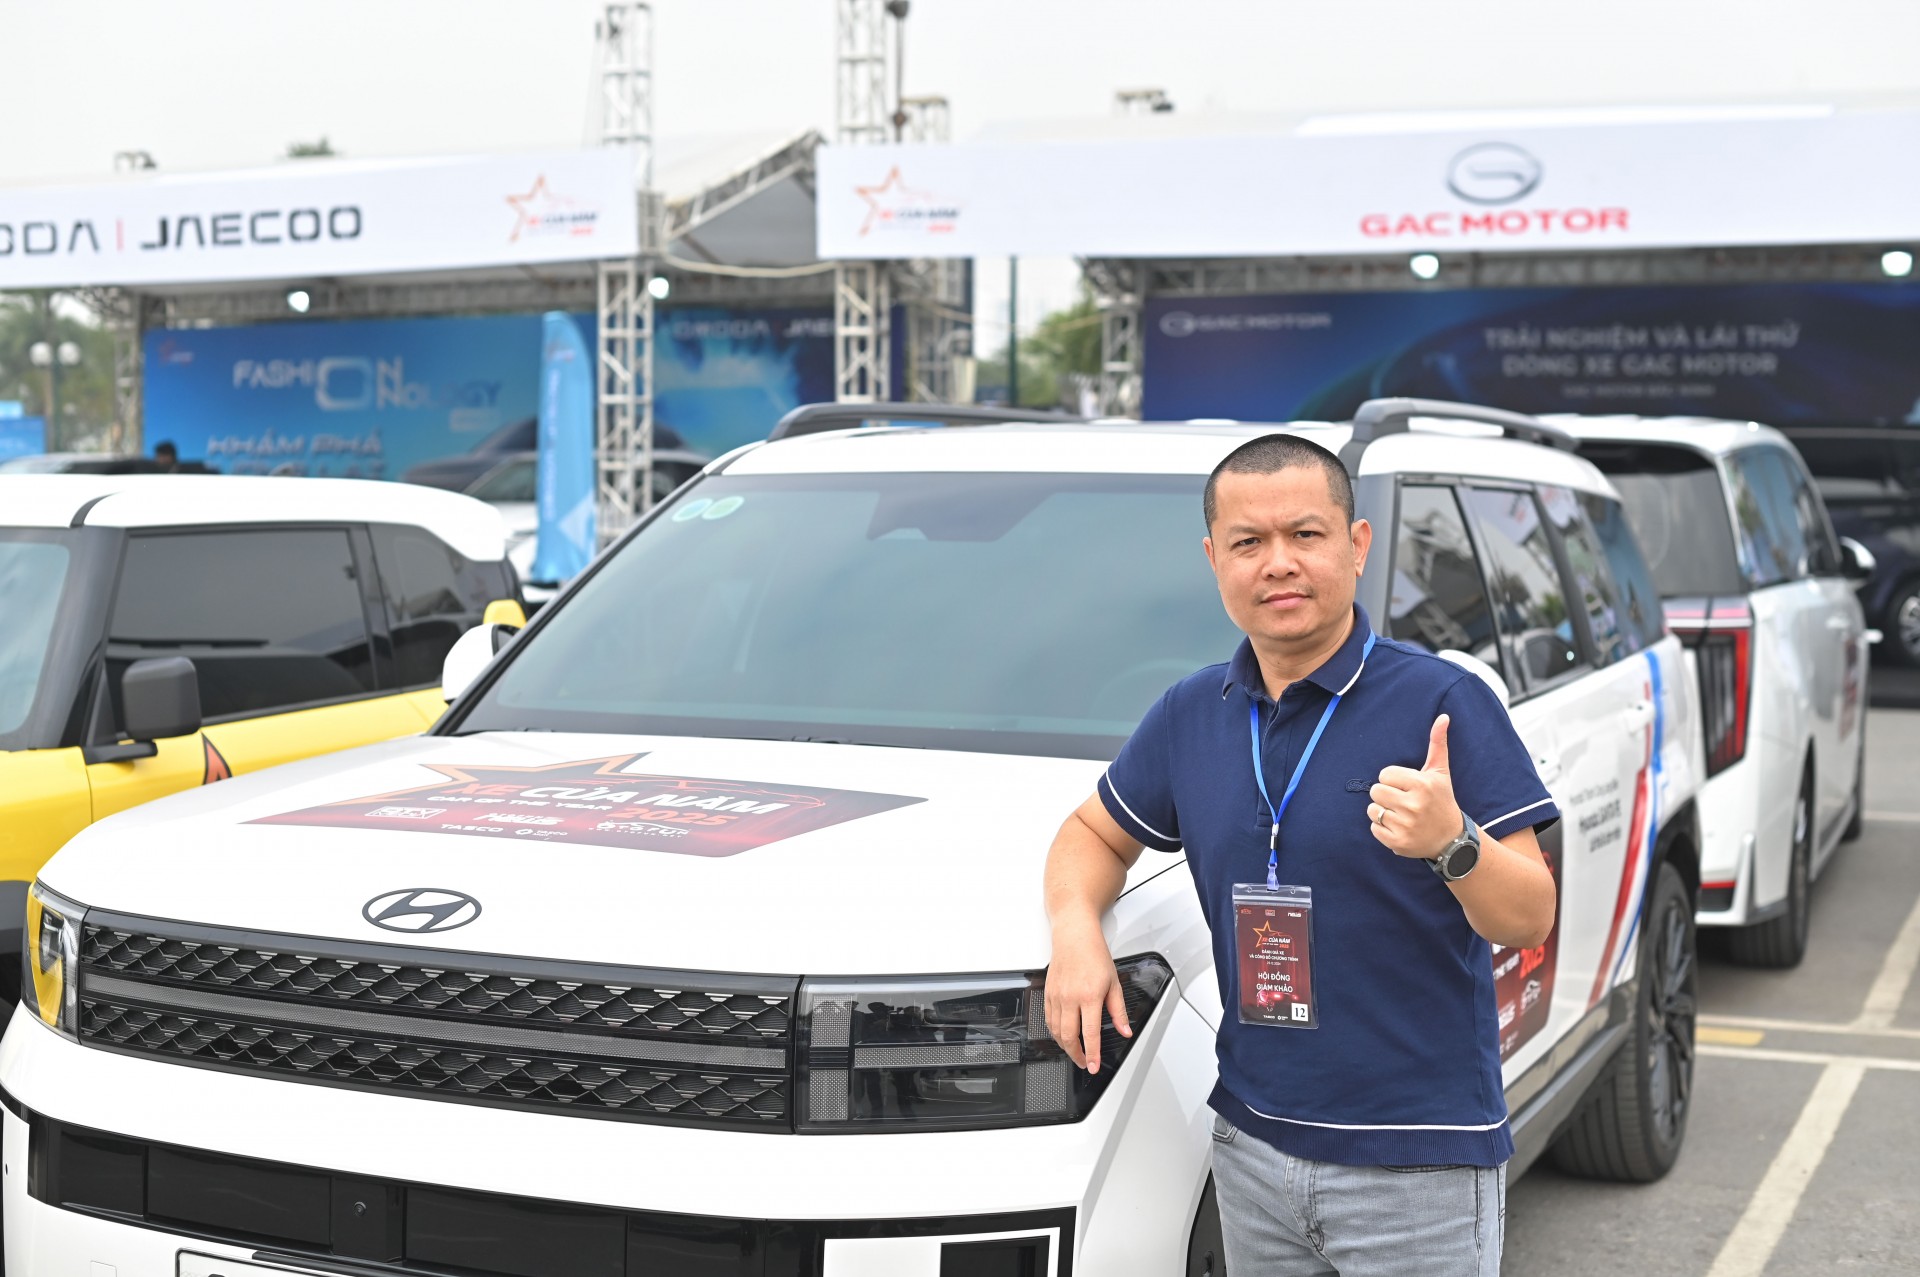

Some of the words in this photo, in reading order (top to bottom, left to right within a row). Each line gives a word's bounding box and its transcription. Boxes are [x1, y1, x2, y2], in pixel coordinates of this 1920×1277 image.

[141, 207, 362, 250] JAECOO
[1360, 212, 1449, 237] GAC
[1460, 208, 1630, 235] MOTOR
[1197, 315, 1242, 331] GAC
[1246, 313, 1331, 330] MOTOR
[1621, 352, 1676, 376] GAC
[1682, 352, 1778, 375] MOTOR
[440, 783, 531, 795] XE
[519, 786, 640, 803] CỦA
[639, 793, 790, 815] NĂM
[509, 799, 550, 807] THE
[555, 802, 612, 811] YEAR
[606, 807, 739, 826] 2025
[441, 824, 503, 833] TASCO
[1256, 981, 1273, 991] GIÁM
[1274, 983, 1294, 993] KHẢO
[1258, 971, 1270, 982] HỘI
[1294, 1007, 1306, 1018] 12
